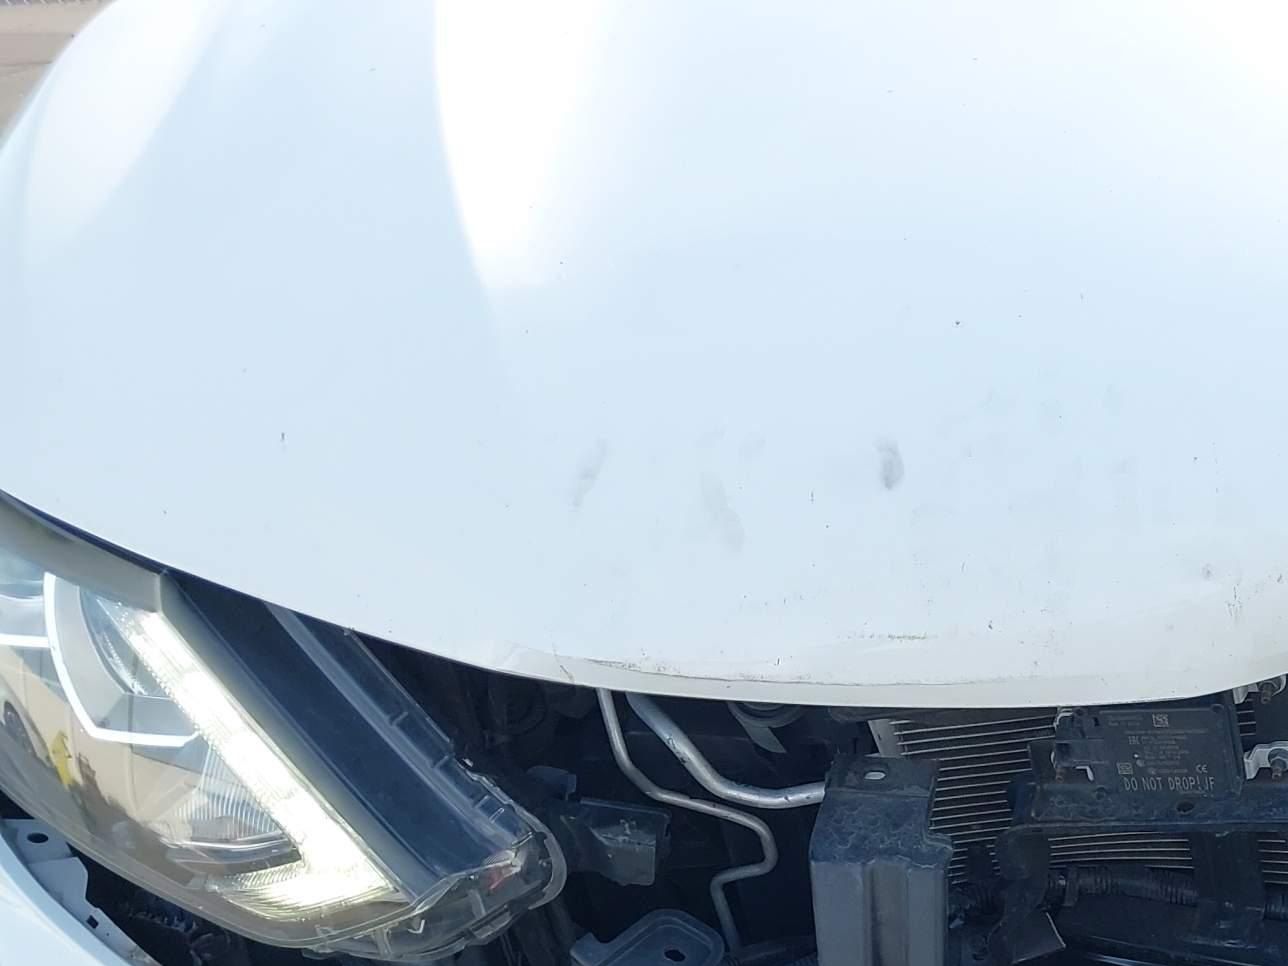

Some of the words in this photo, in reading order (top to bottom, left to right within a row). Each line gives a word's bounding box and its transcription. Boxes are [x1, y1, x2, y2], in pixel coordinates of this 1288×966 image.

[1123, 776, 1138, 791] DO
[1142, 776, 1162, 791] NOT
[1168, 776, 1201, 791] DROP!
